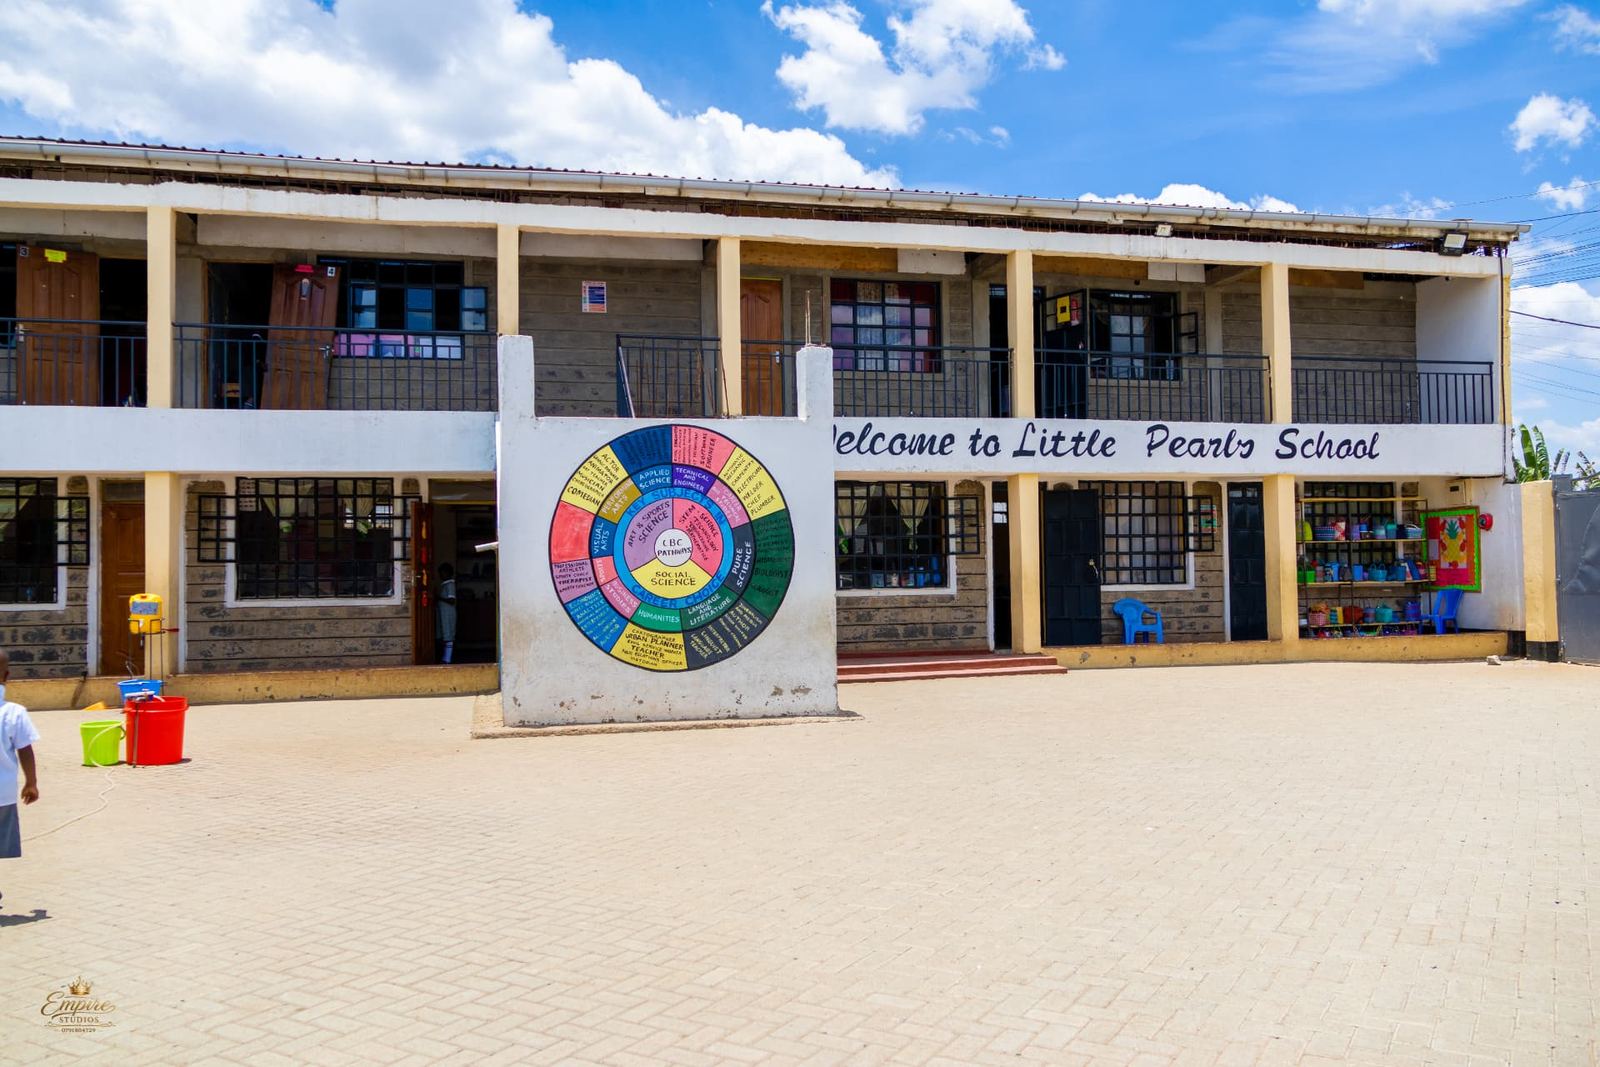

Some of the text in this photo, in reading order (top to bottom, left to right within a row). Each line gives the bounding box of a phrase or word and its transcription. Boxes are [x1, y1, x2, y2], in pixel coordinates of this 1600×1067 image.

[968, 428, 1002, 457] to
[1012, 422, 1116, 457] Little
[1146, 424, 1254, 458] Pearls
[1275, 428, 1380, 460] School
[589, 461, 613, 483] ANIMATOR
[602, 454, 619, 472] ACTOR
[639, 477, 672, 489] SCIENCE
[640, 468, 670, 480] APPLIED
[676, 468, 710, 482] TECHNICAL
[737, 466, 761, 493] ELECTRICIAN
[674, 479, 704, 492] ENGINEER
[743, 482, 763, 500] WELDER
[568, 487, 600, 505] COMEDIAN
[747, 494, 760, 508] CHEF
[751, 495, 774, 514] PLUMBER
[628, 497, 646, 516] KEY
[678, 504, 696, 523] STEM
[628, 530, 638, 548] ART
[642, 501, 670, 521] SPORTS
[638, 510, 669, 544] SCIENCE
[700, 512, 718, 538] SCIENCE
[594, 522, 604, 554] VISUAL
[600, 530, 610, 550] ARTS
[662, 538, 683, 546] CBC
[732, 548, 743, 574] PURE
[736, 541, 752, 587] SCIENCE
[631, 584, 677, 608] CAREER
[685, 574, 724, 606] CHOICE
[651, 578, 696, 586] SCIENCE
[688, 594, 721, 614] LANGUAGE
[690, 597, 731, 626] LITERATURE
[700, 605, 712, 615] AND
[638, 610, 680, 624] HUMANITIES
[730, 611, 749, 630] AUTHOR
[632, 646, 664, 658] TEACHER
[651, 639, 683, 650] PLANNER
